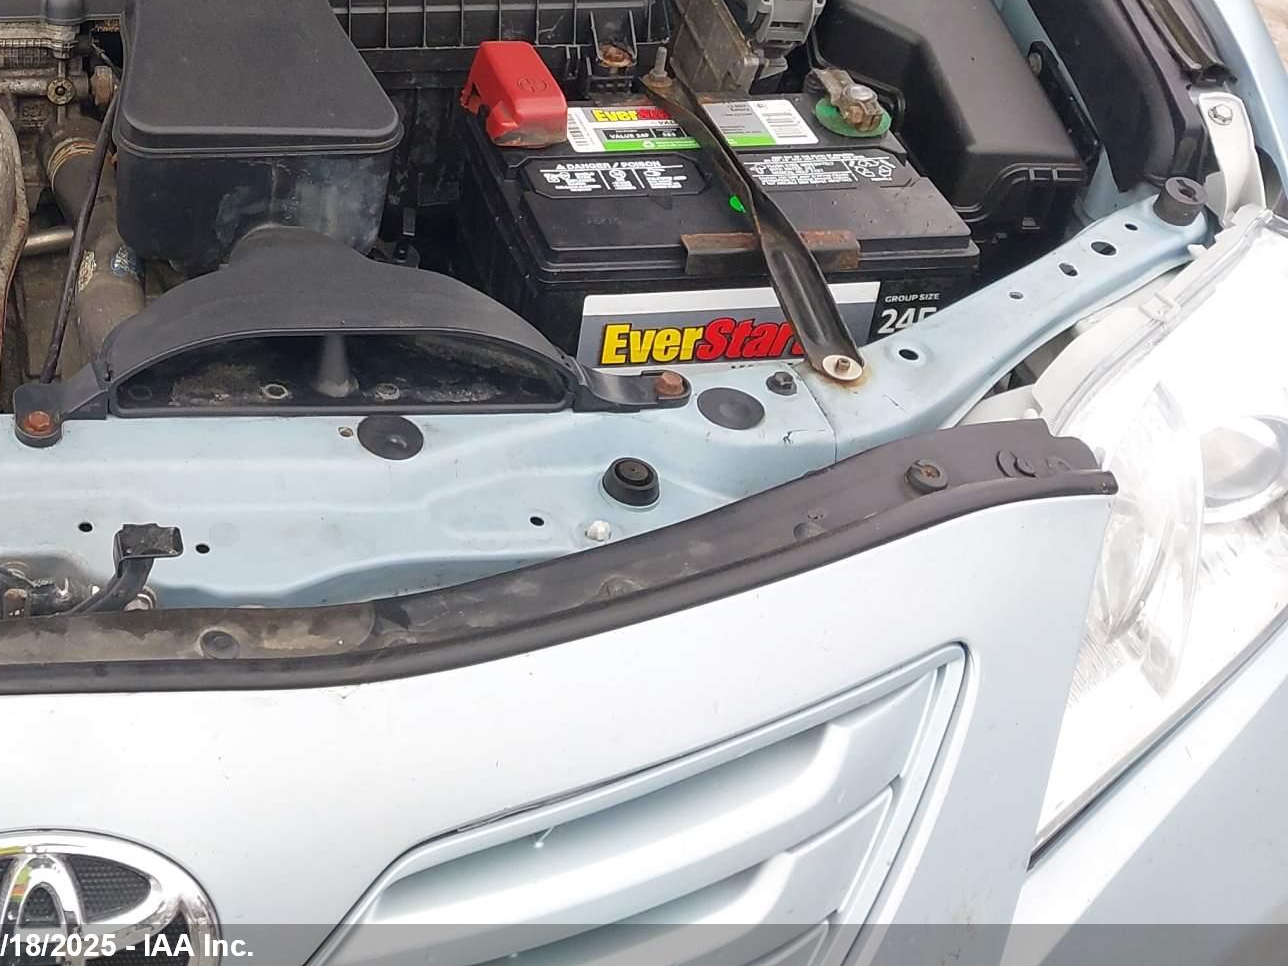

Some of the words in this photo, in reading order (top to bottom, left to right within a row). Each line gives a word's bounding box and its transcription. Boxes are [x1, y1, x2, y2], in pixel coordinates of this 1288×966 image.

[567, 162, 610, 170] DANGER
[621, 161, 662, 169] POISON
[885, 294, 918, 303] GROUP
[919, 293, 940, 301] SIZE
